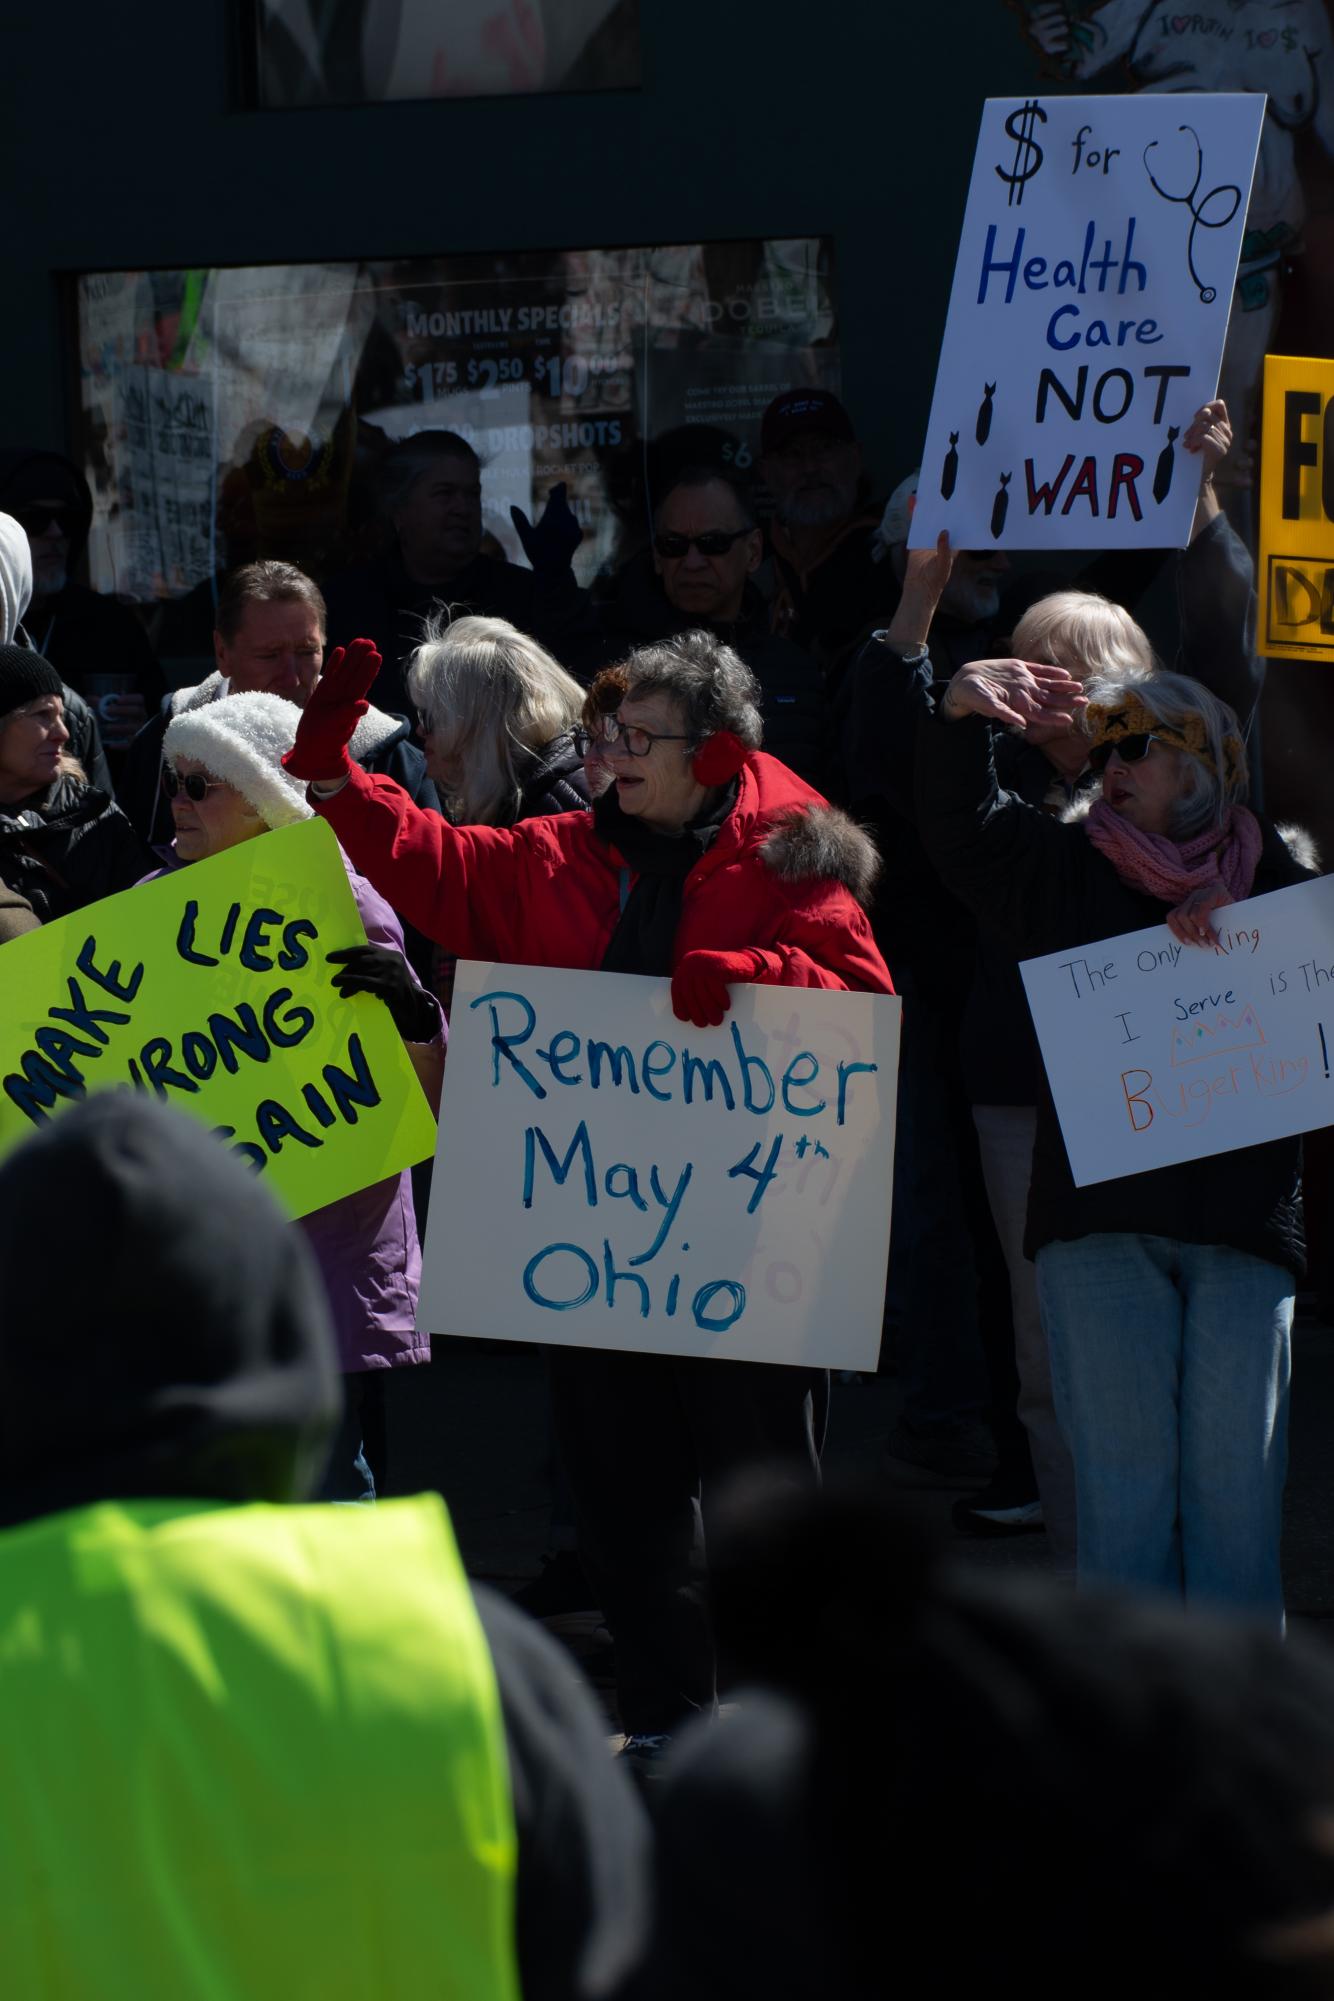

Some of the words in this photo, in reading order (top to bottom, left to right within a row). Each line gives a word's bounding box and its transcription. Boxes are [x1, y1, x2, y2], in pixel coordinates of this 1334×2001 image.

[1191, 13, 1234, 42] PUTIN
[995, 100, 1047, 206] $
[1072, 126, 1120, 174] for
[977, 217, 1147, 304] Health
[407, 307, 511, 338] MONTHLY
[517, 303, 620, 332] SPECIALS
[1046, 305, 1163, 350] Care
[1035, 365, 1190, 424] NOT
[1024, 453, 1143, 521] WAR
[1059, 959, 1118, 998] The
[1137, 943, 1182, 972] Only
[3, 935, 144, 1129] MAKE
[177, 900, 318, 972] LIES
[117, 988, 314, 1101] RONG
[1115, 1012, 1141, 1044] I
[1175, 989, 1236, 1021] Serve
[470, 991, 878, 1126] Remember
[523, 1119, 693, 1266] May
[522, 1239, 746, 1332] Ohio
